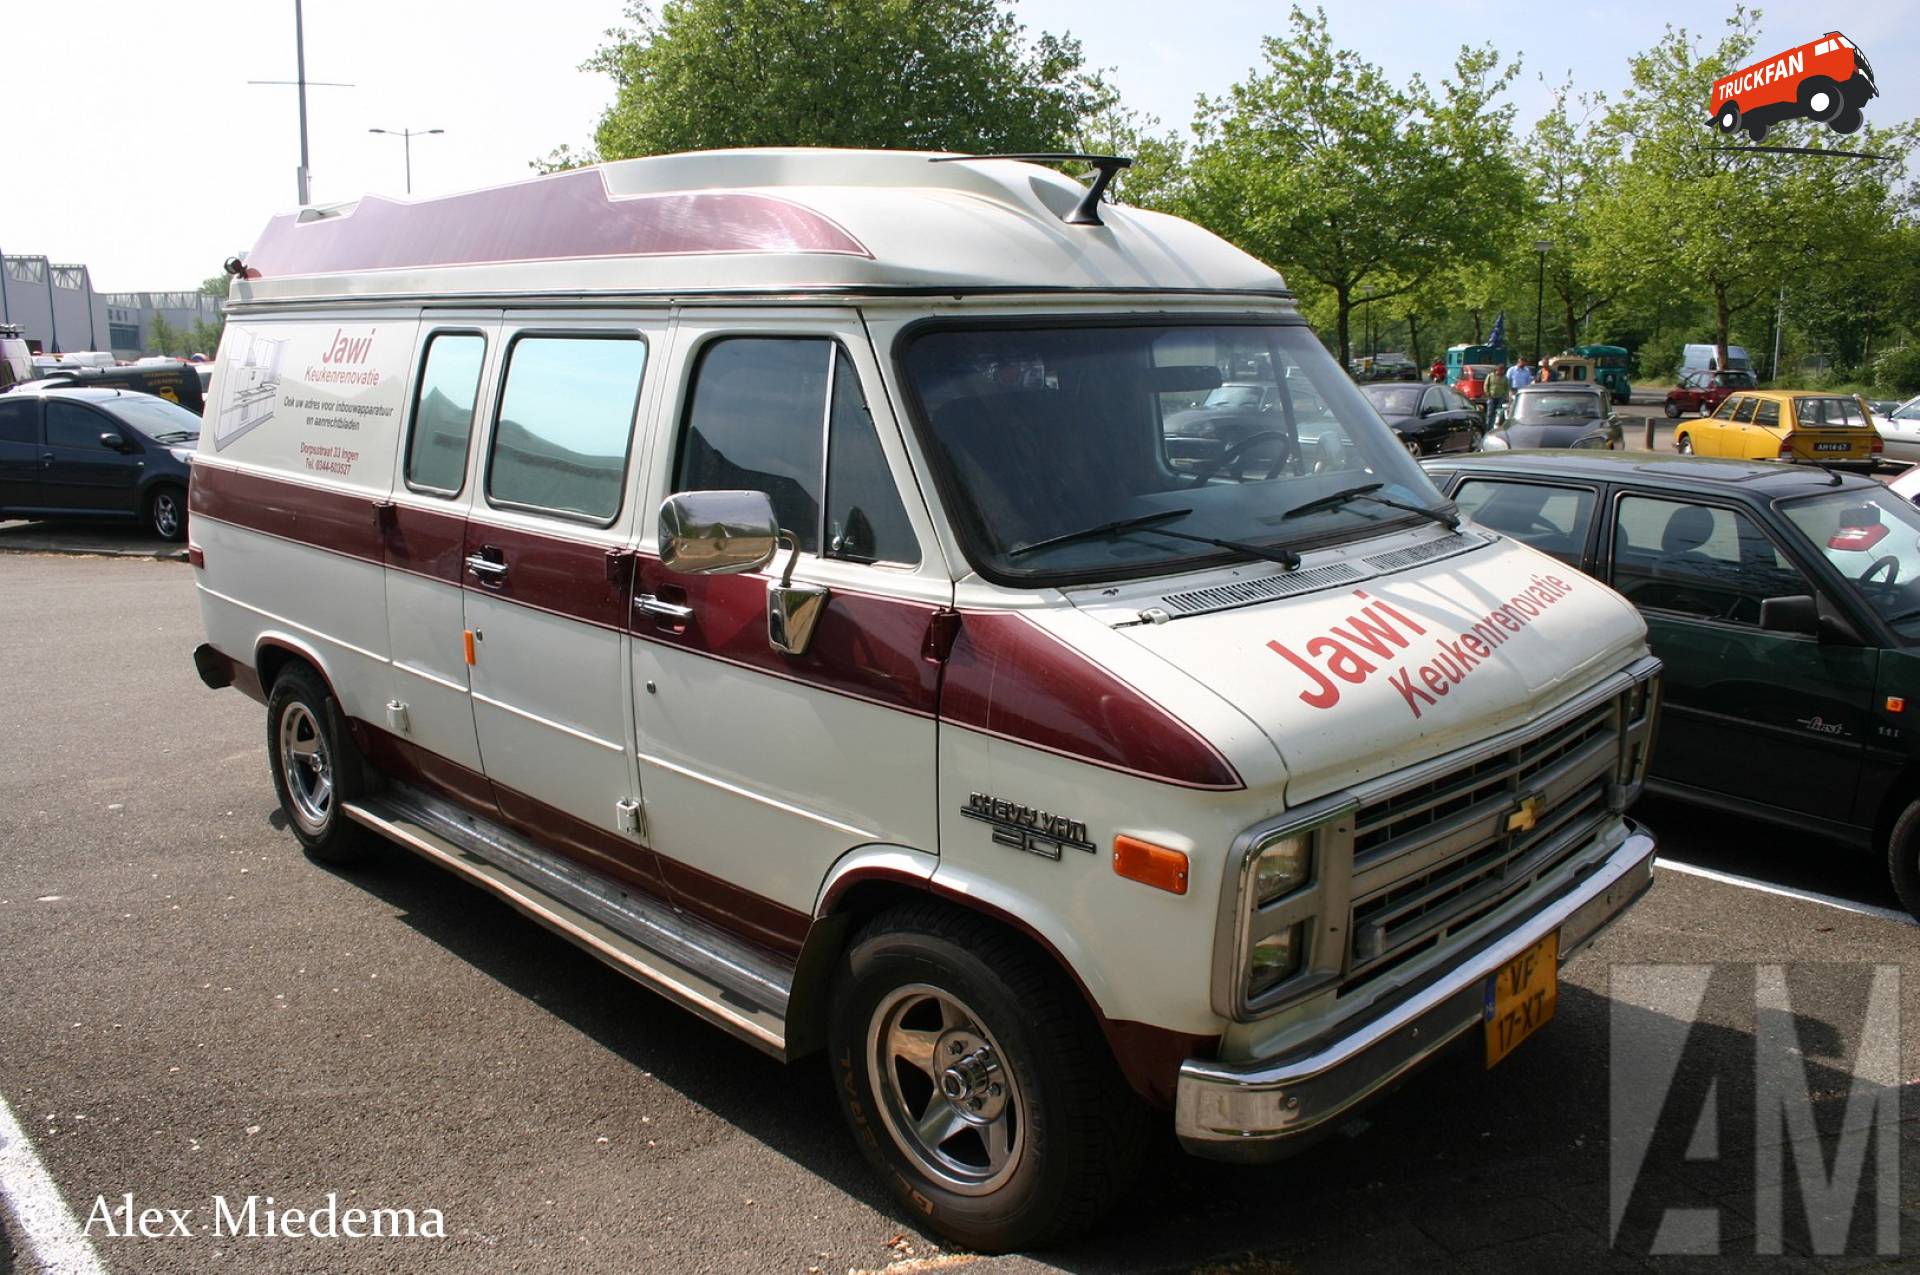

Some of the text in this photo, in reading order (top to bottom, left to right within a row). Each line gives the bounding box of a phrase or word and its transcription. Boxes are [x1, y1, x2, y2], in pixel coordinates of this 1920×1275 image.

[322, 328, 376, 364] Jawi
[304, 365, 381, 386] Keukenrenovatie
[304, 398, 320, 410] adres
[321, 402, 335, 411] voor
[306, 416, 314, 425] en
[1266, 589, 1427, 709] Jawi
[1388, 574, 1573, 719] Keukenrenovatie
[969, 791, 1087, 842] CHEVY VAN
[1511, 954, 1535, 996] VF
[1498, 989, 1546, 1052] 17-XT
